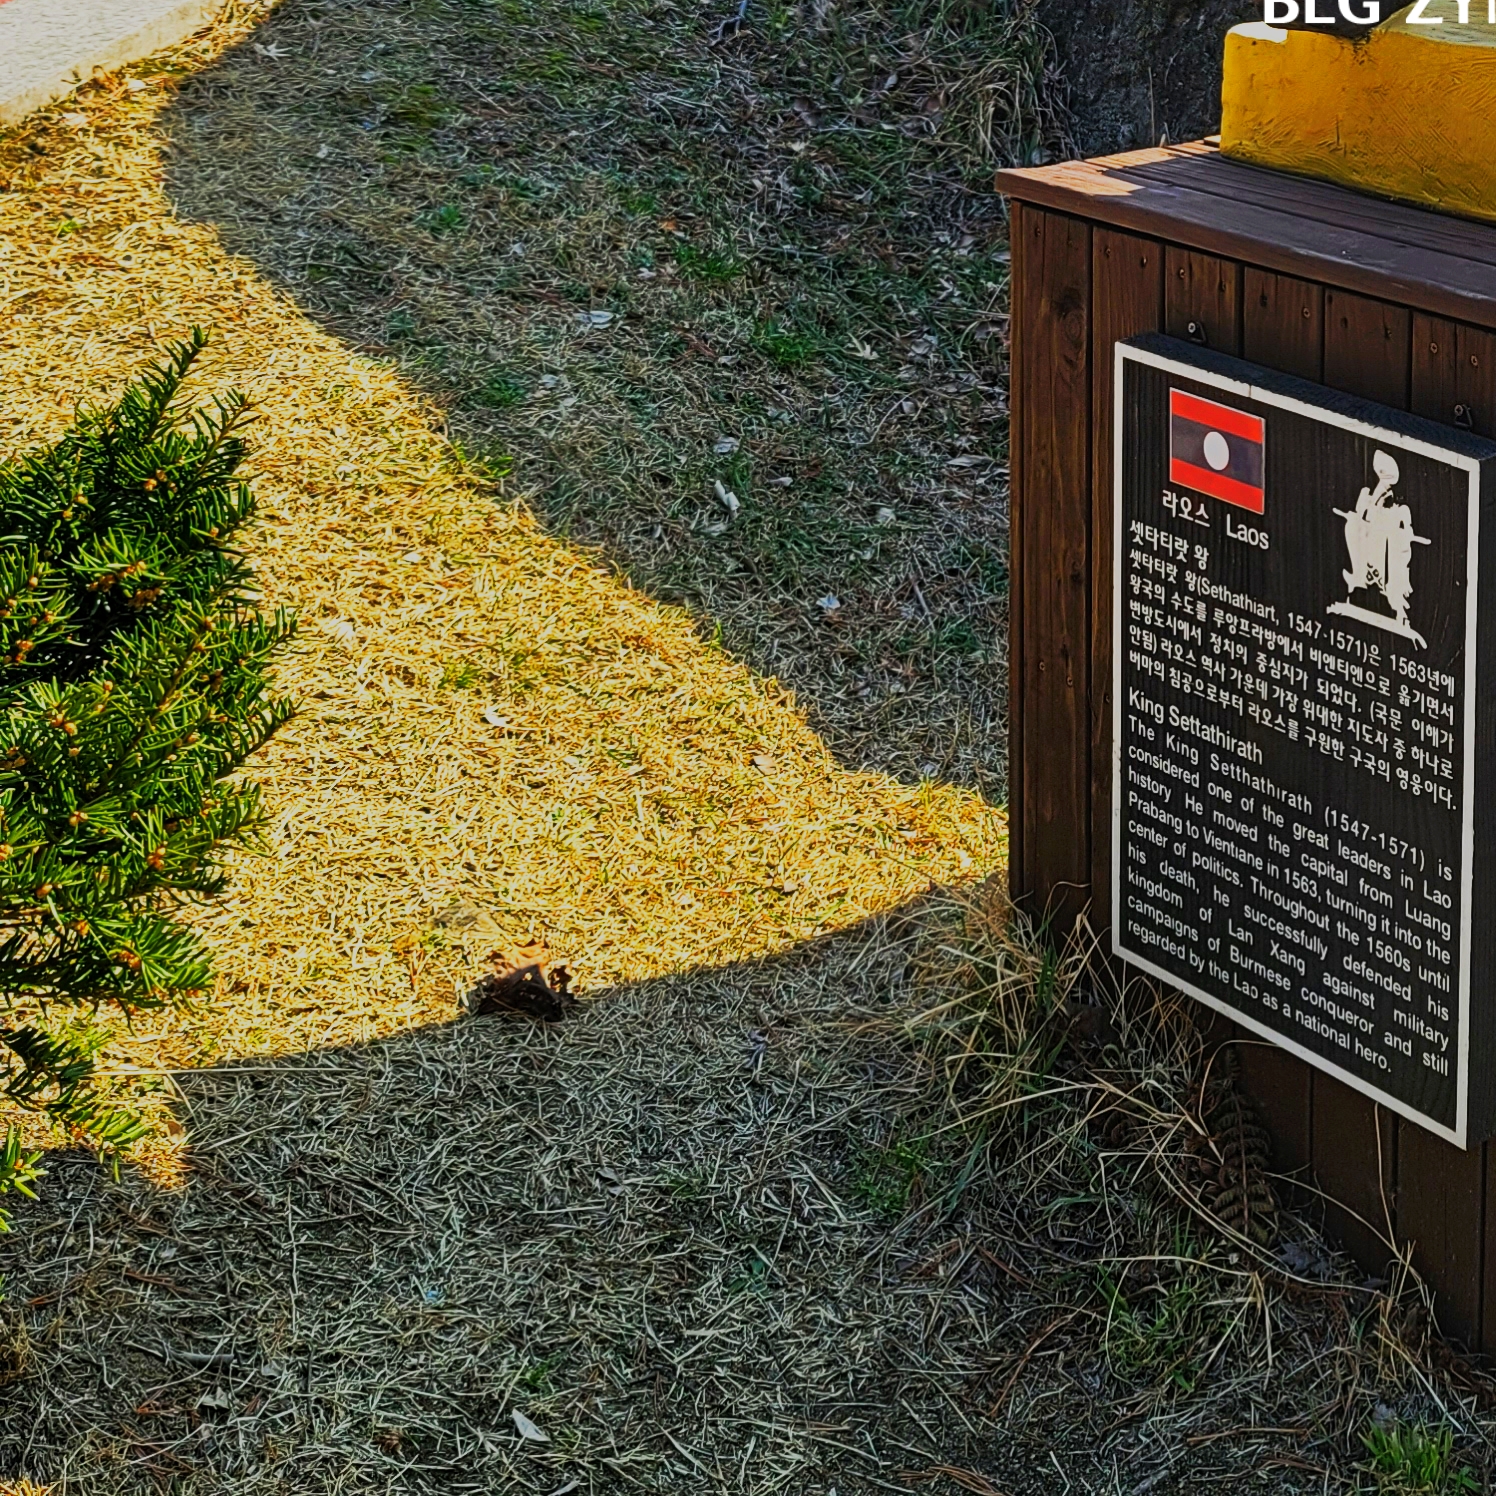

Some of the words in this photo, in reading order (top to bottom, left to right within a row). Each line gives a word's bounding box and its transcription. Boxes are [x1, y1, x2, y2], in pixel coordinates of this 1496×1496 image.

[1129, 519, 1190, 563] 셋타티랏
[1193, 544, 1210, 570] 왕
[1162, 489, 1210, 528] 라오스
[1226, 513, 1269, 550] Laos
[1129, 548, 1178, 584] 셋타티랏
[1389, 654, 1455, 698] 1563년에
[1129, 573, 1165, 605] 왕국의
[1170, 591, 1207, 622] 수도를
[1212, 607, 1303, 662] 루앙프라방에서
[1309, 647, 1391, 697] 비엔티엔으로
[1129, 599, 1202, 646] 변방도시에서
[1209, 632, 1248, 665] 정치의
[1255, 651, 1309, 691] 중심지가
[1316, 678, 1362, 713] 되었다.
[1370, 700, 1403, 732] (국문
[1411, 718, 1454, 754] 이해가
[1129, 624, 1157, 654] 안됨)
[1160, 637, 1197, 668] 라오스
[1201, 654, 1226, 682] 역사
[1230, 667, 1268, 701] 가운데
[1272, 685, 1299, 713] 가장
[1302, 698, 1343, 733] 위대한
[1347, 717, 1389, 753] 지도자
[1392, 737, 1407, 761] 중
[1410, 745, 1454, 780] 하나로
[1129, 686, 1164, 725] King
[1168, 704, 1263, 765] Settathirath
[1129, 649, 1165, 682] 버마의
[1169, 667, 1243, 717] 침공으로부터
[1248, 701, 1300, 741] 라오스를
[1304, 726, 1345, 761] 구원한
[1349, 745, 1390, 783] 구국의
[1395, 767, 1457, 810] 영웅이다.
[1128, 714, 1155, 741] The
[1166, 732, 1199, 766] King
[1324, 806, 1425, 872] (1547-1571)
[1438, 858, 1453, 881] is
[1128, 745, 1200, 788] considered
[1207, 782, 1233, 804] one
[1240, 797, 1255, 813] of
[1262, 804, 1284, 828] the
[1292, 822, 1329, 851] great
[1338, 839, 1392, 880] leaders
[1400, 868, 1414, 891] in
[1423, 879, 1452, 909] Lao
[1185, 792, 1204, 816] He
[1213, 810, 1258, 842] moved
[1268, 833, 1290, 858] the
[1301, 853, 1348, 887] capital
[1359, 877, 1393, 909] from
[1405, 899, 1451, 941] Luang
[1128, 819, 1169, 848] center
[1173, 842, 1187, 858] of
[1192, 851, 1244, 888] politics.
[1250, 875, 1330, 932] Throughout
[1336, 920, 1360, 946] the
[1366, 936, 1411, 972] 1560s
[1418, 965, 1450, 993] until
[1128, 841, 1147, 865] his
[1159, 859, 1200, 894] death,
[1213, 885, 1230, 907] he
[1244, 904, 1328, 961] successfully
[1342, 954, 1412, 1002] defended
[1427, 994, 1449, 1021] his
[1129, 790, 1183, 835] Prabang
[1185, 819, 1200, 839] to
[1202, 826, 1263, 871] Vientiane
[1267, 862, 1279, 879] in
[1284, 868, 1322, 903] 1563,
[1325, 888, 1377, 932] turning
[1381, 914, 1391, 935] it
[1394, 921, 1422, 950] into
[1426, 938, 1451, 965] the
[1128, 865, 1183, 909] kingdom
[1199, 907, 1212, 924] of
[1228, 918, 1253, 945] Lan
[1270, 939, 1306, 976] Xang
[1322, 972, 1375, 1010] against
[1393, 1008, 1449, 1052] military
[1128, 895, 1199, 942] campaigns
[1207, 937, 1220, 953] of
[1230, 944, 1291, 991] Burmese
[1301, 987, 1375, 1035] conqueror
[1384, 1031, 1412, 1057] and
[1422, 1052, 1448, 1077] still
[1128, 919, 1186, 960] regarded
[1189, 948, 1205, 973] by
[1208, 960, 1230, 984] the
[1233, 972, 1259, 999] Lao
[1262, 992, 1278, 1010] as
[1282, 1003, 1291, 1018] a
[1295, 1009, 1350, 1050] national
[1355, 1037, 1391, 1073] hero.
